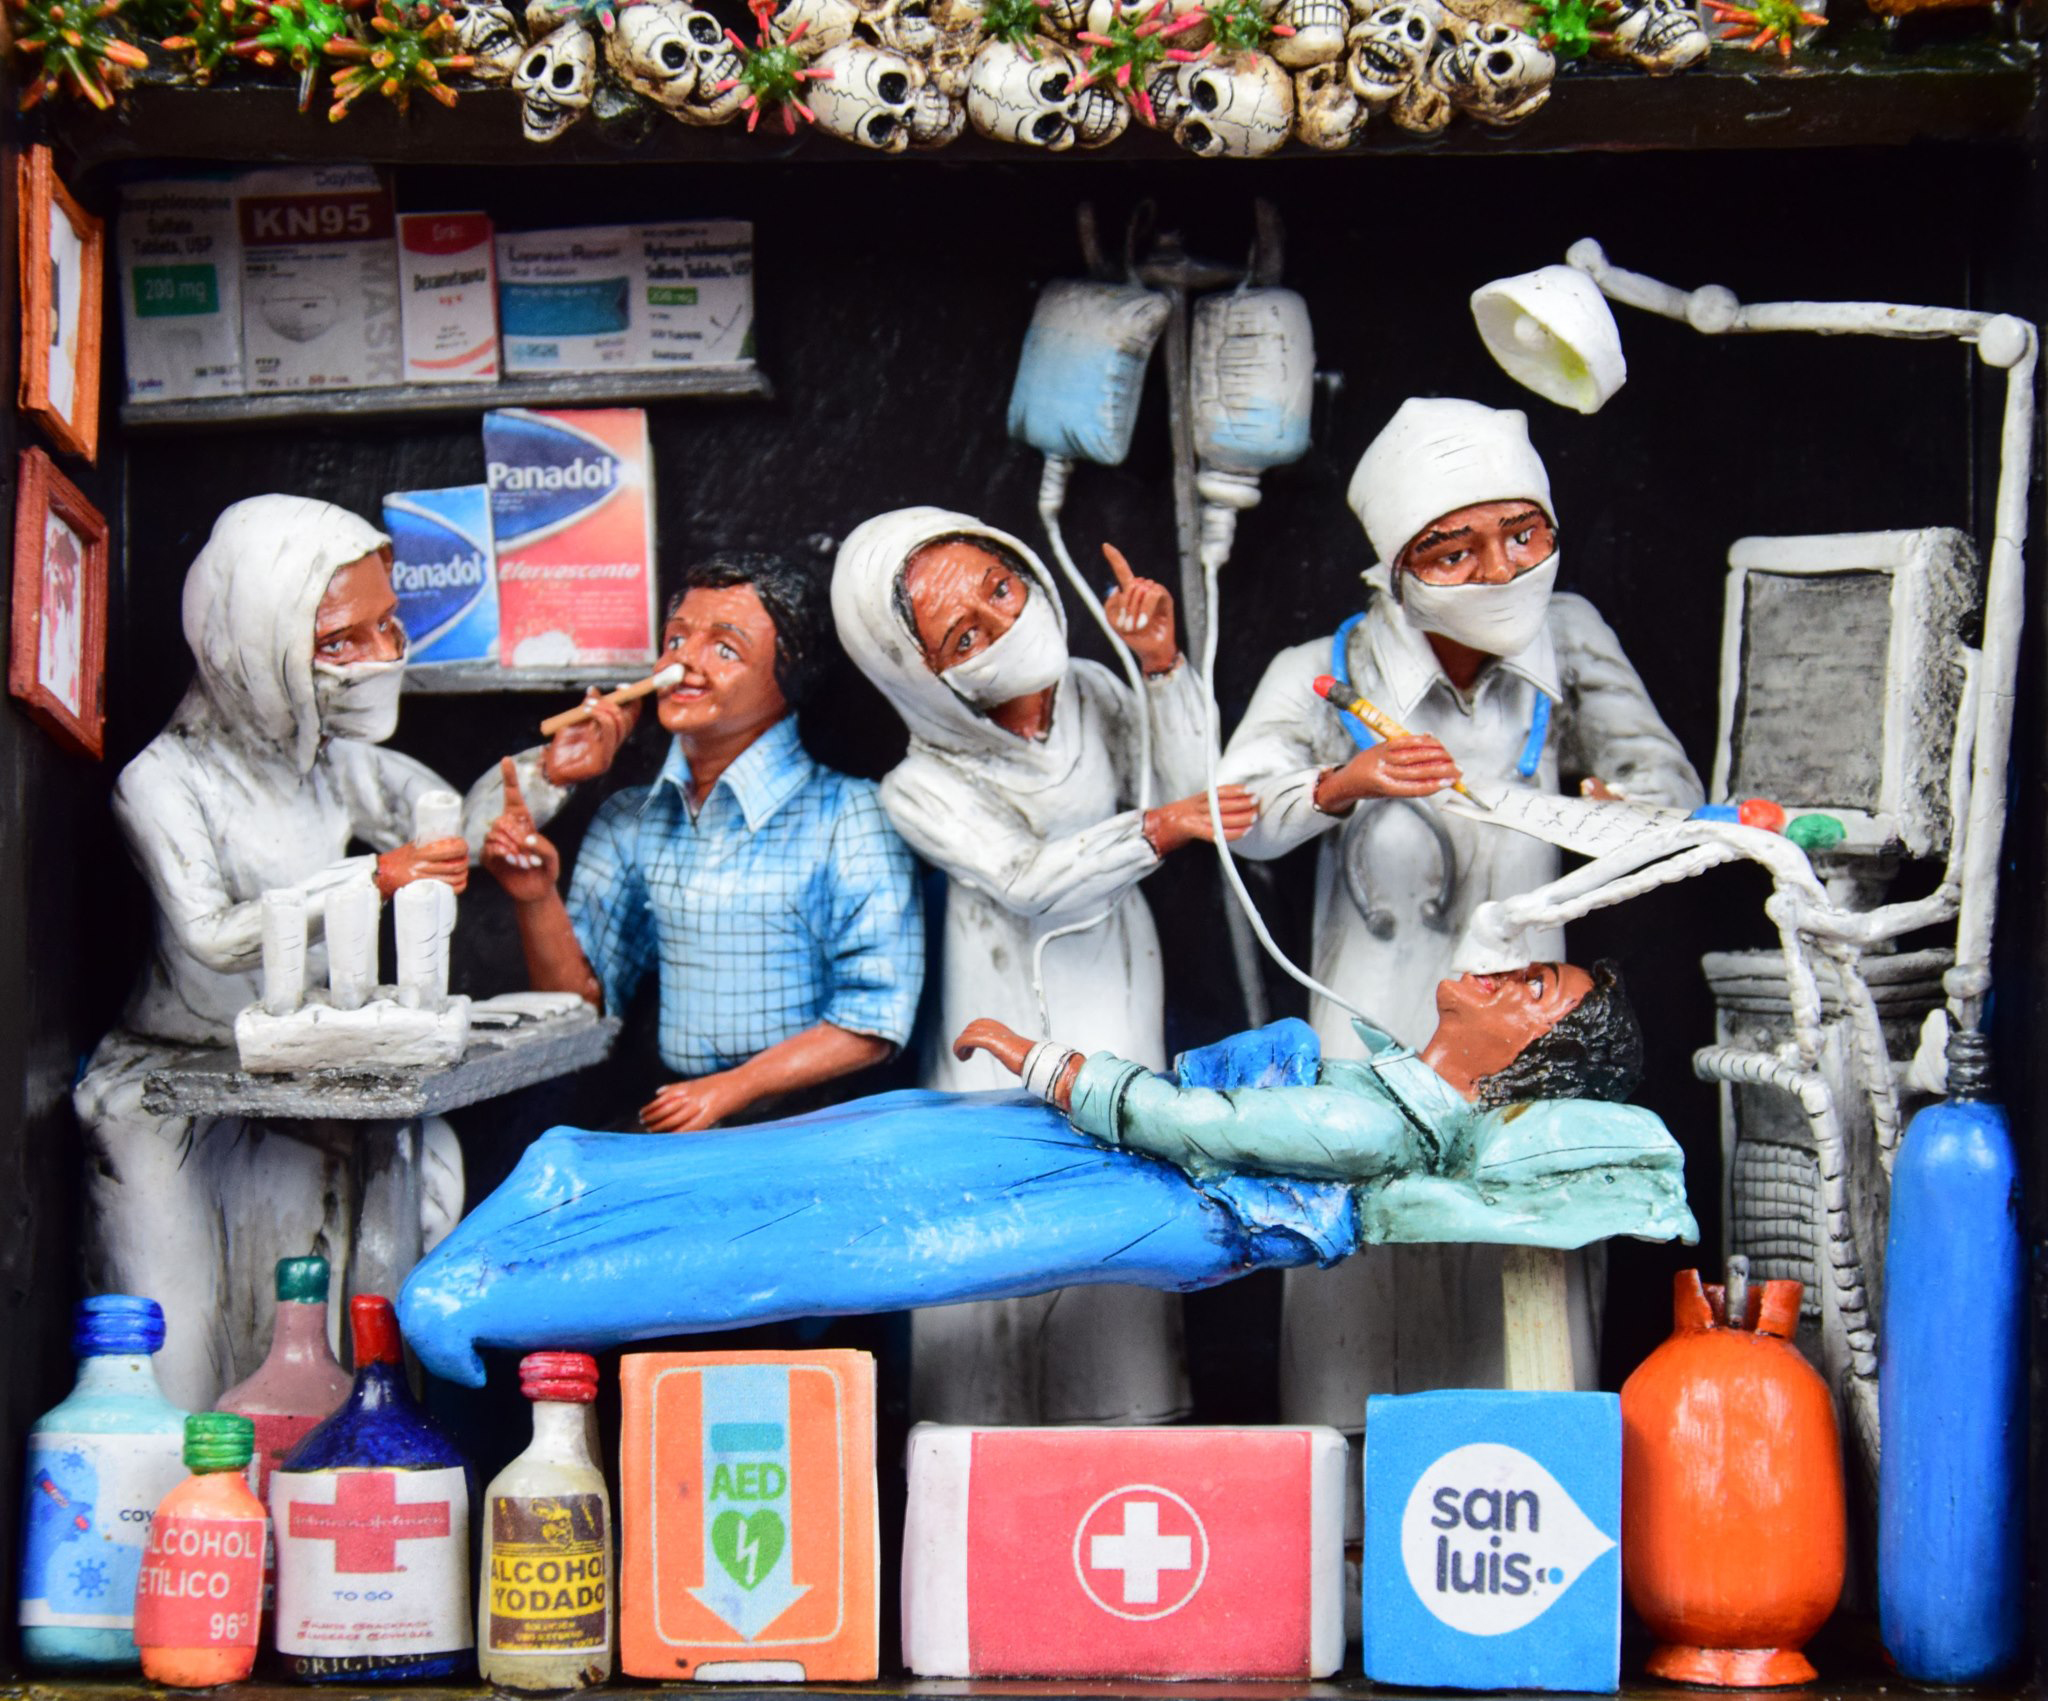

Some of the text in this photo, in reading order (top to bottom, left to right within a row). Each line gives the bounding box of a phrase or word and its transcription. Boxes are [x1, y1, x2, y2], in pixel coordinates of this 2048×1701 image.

[254, 203, 371, 239] KN95
[144, 279, 207, 302] 200 mg
[487, 457, 612, 490] Panadol
[392, 554, 482, 590] Panadol
[500, 561, 641, 582] Efervescente
[708, 1462, 787, 1502] AED
[1431, 1486, 1541, 1533] san
[150, 1527, 257, 1558] LCOHOL
[137, 1560, 231, 1600] ETÍLICO
[333, 1590, 394, 1601] TO GO
[494, 1581, 606, 1612] YODADO
